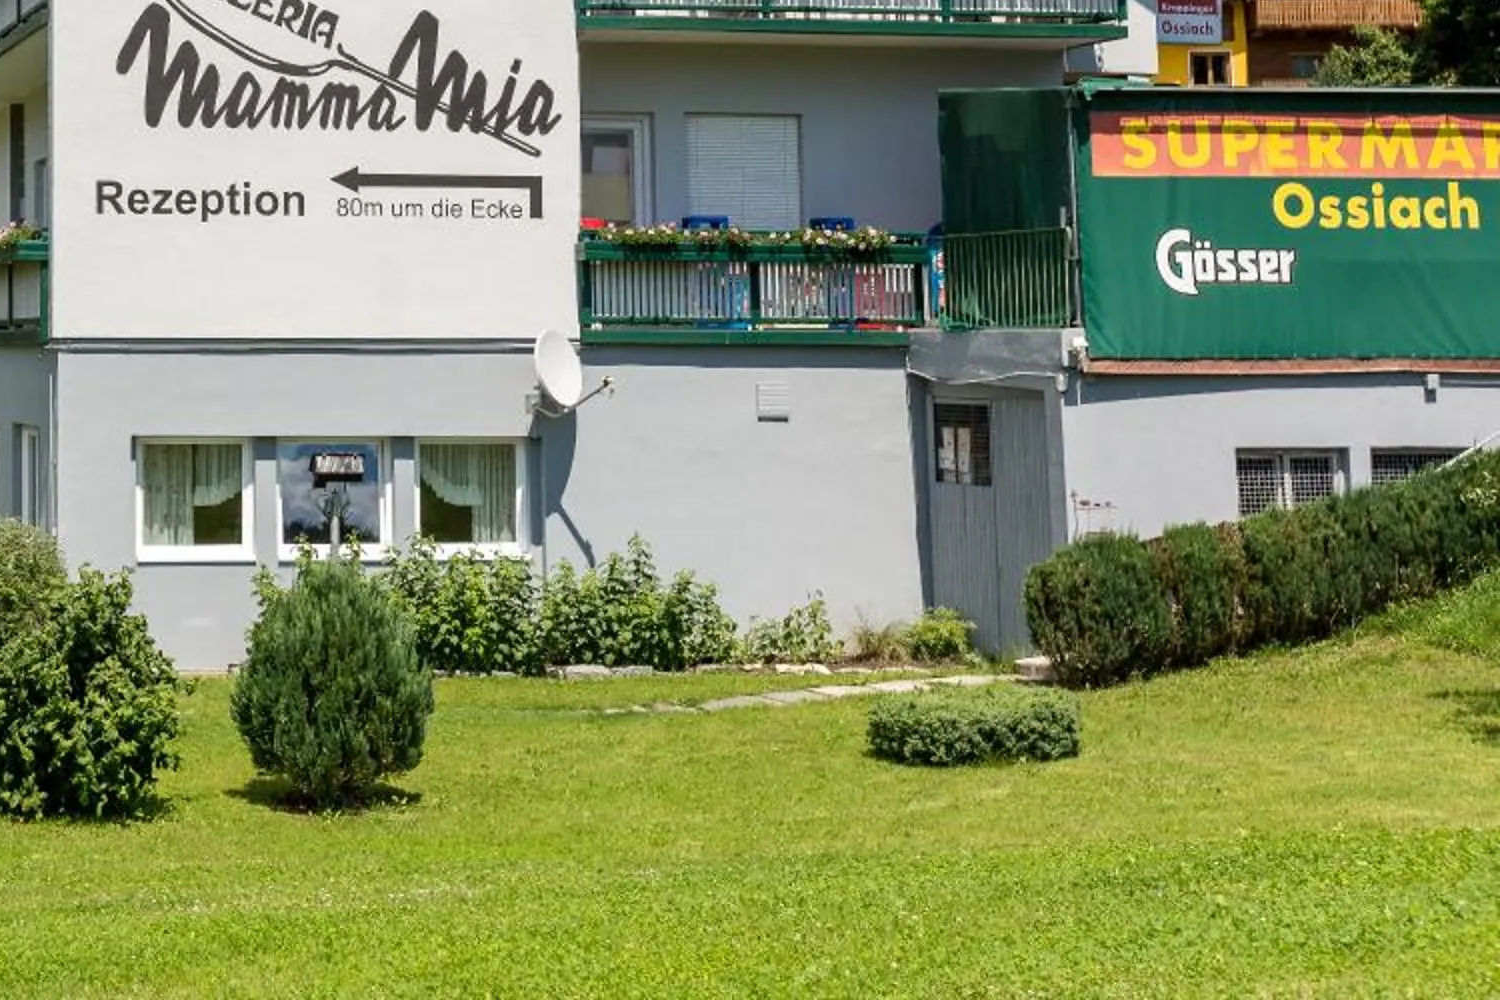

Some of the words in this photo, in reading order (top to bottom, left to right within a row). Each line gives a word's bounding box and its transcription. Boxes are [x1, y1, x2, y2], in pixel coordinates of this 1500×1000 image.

[1161, 20, 1213, 35] Ossiach
[116, 2, 405, 129] Mamma
[388, 10, 562, 136] Mia
[97, 181, 305, 222] Rezeption
[336, 197, 384, 218] 80m
[390, 203, 424, 218] um
[430, 198, 463, 219] die
[471, 199, 523, 219] Ecke
[1272, 181, 1481, 229] Ossiach
[1156, 228, 1297, 296] Gösser
